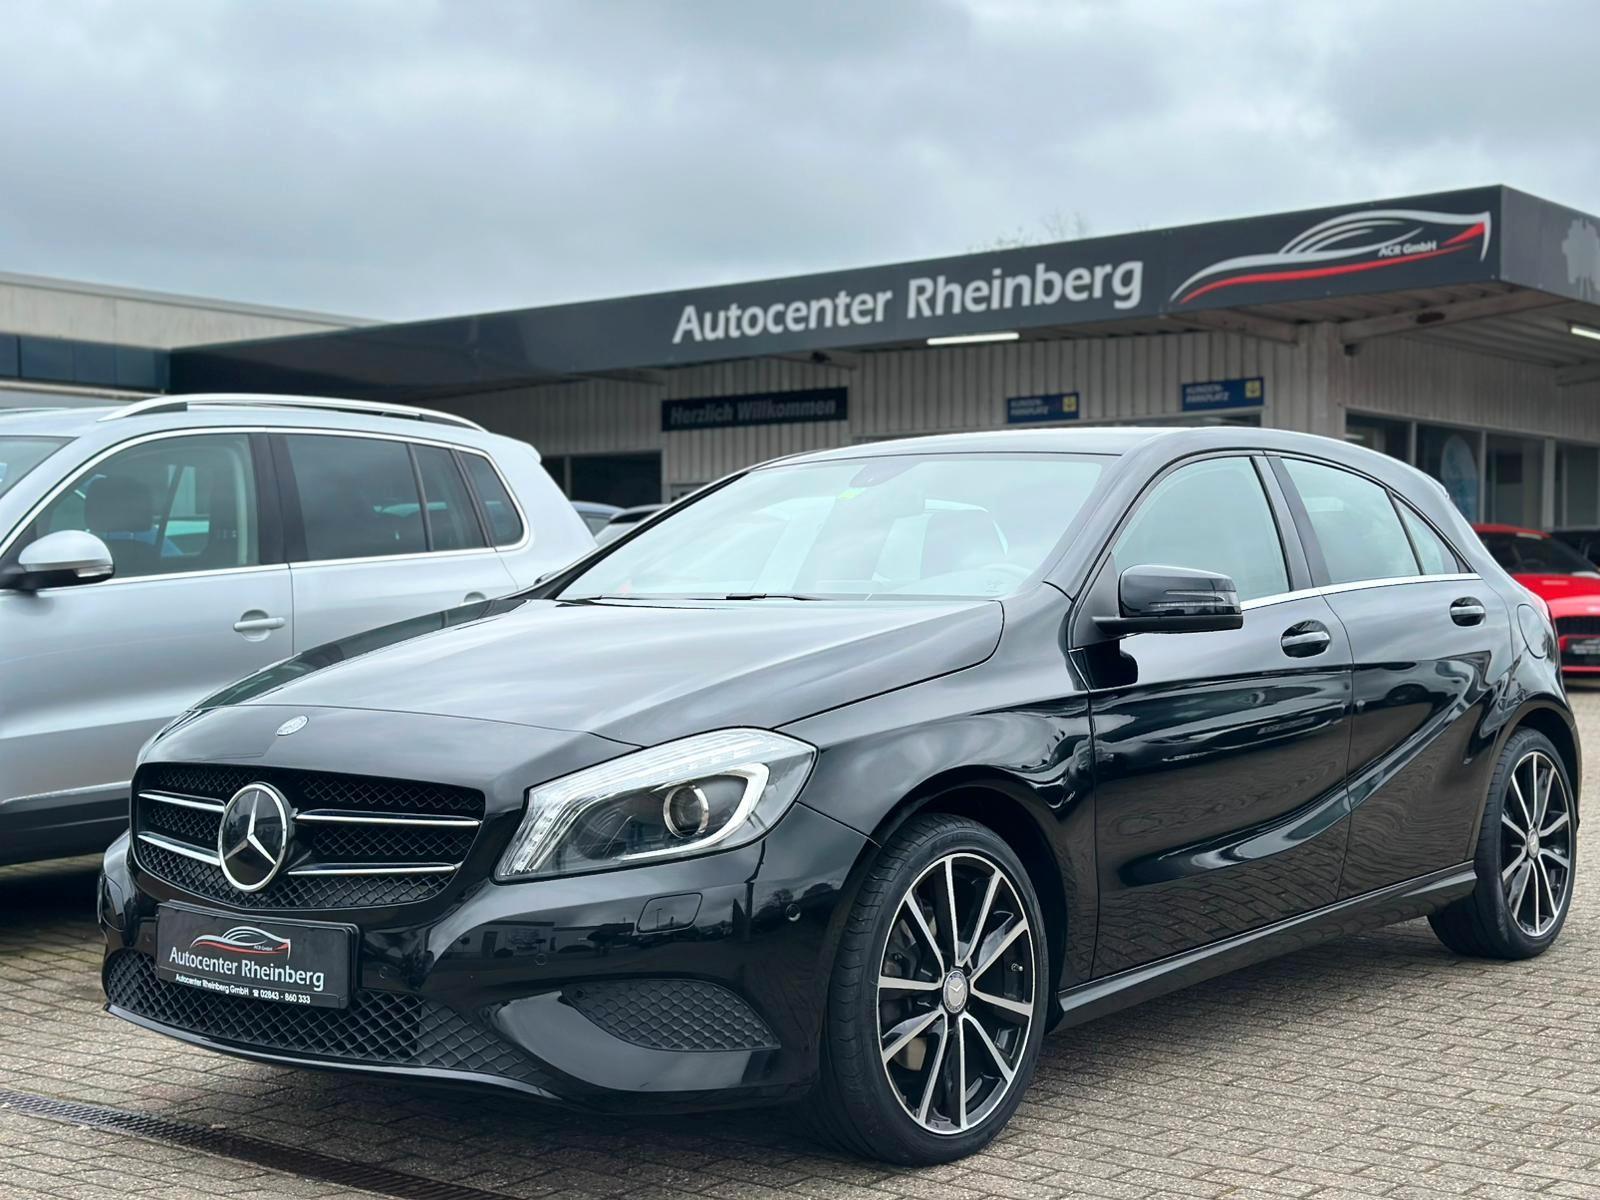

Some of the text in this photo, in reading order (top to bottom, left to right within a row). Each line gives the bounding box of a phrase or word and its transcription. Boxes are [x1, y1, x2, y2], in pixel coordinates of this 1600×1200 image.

[1402, 240, 1437, 255] GmbH
[672, 260, 1145, 345] Autocenter Rheinberg
[670, 398, 837, 425] Herzlich Willkommen
[169, 946, 325, 991] Autocenter Rheinberg
[175, 973, 202, 987] Autocenter
[202, 979, 230, 994] Rheinberg
[229, 985, 249, 996] GmbH
[260, 989, 279, 1000] 02843
[298, 994, 311, 1004] 333
